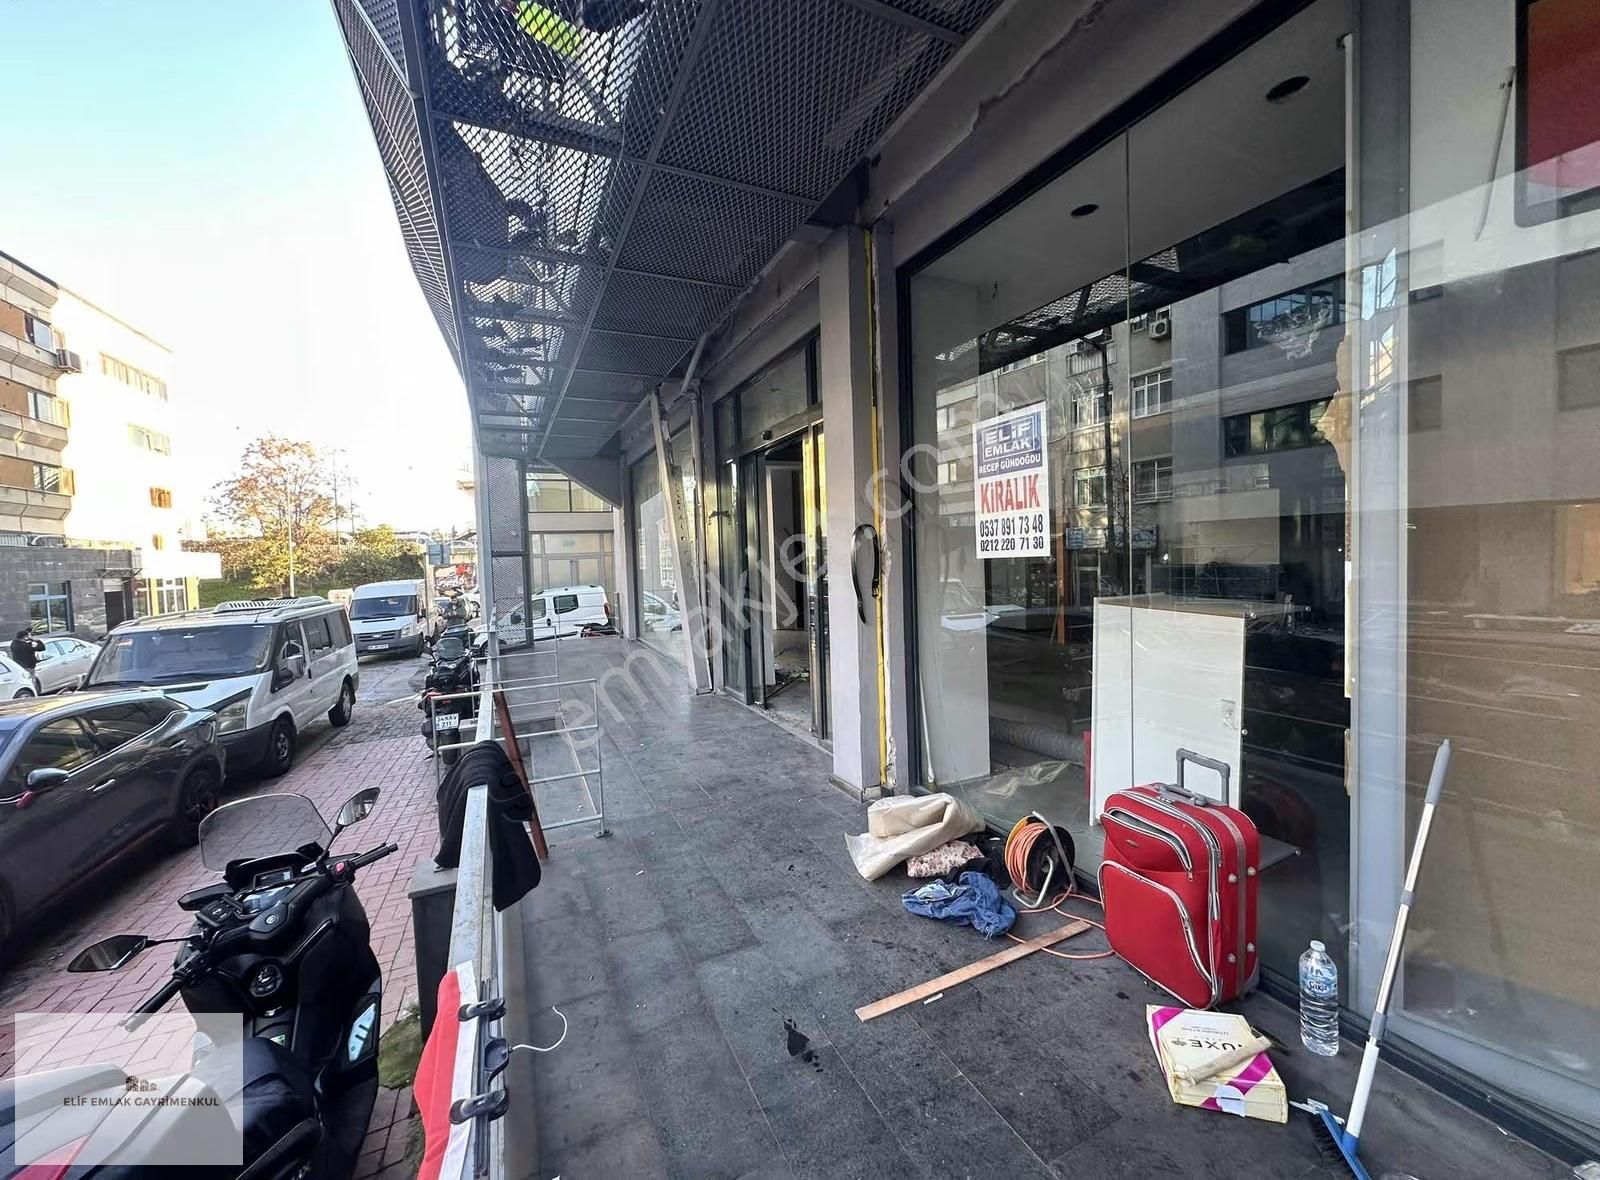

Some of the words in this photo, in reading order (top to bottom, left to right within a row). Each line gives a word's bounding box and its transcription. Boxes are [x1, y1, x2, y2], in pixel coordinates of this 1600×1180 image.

[984, 438, 1032, 458] EMLAK
[979, 462, 1000, 474] RECEP
[979, 519, 999, 538] 0537
[1001, 517, 1016, 536] 891
[1019, 516, 1030, 535] 73
[1032, 514, 1044, 534] 48
[980, 539, 1000, 552] 0212
[1001, 538, 1016, 551] 220
[1020, 537, 1030, 550] 71
[1033, 536, 1044, 550] 30
